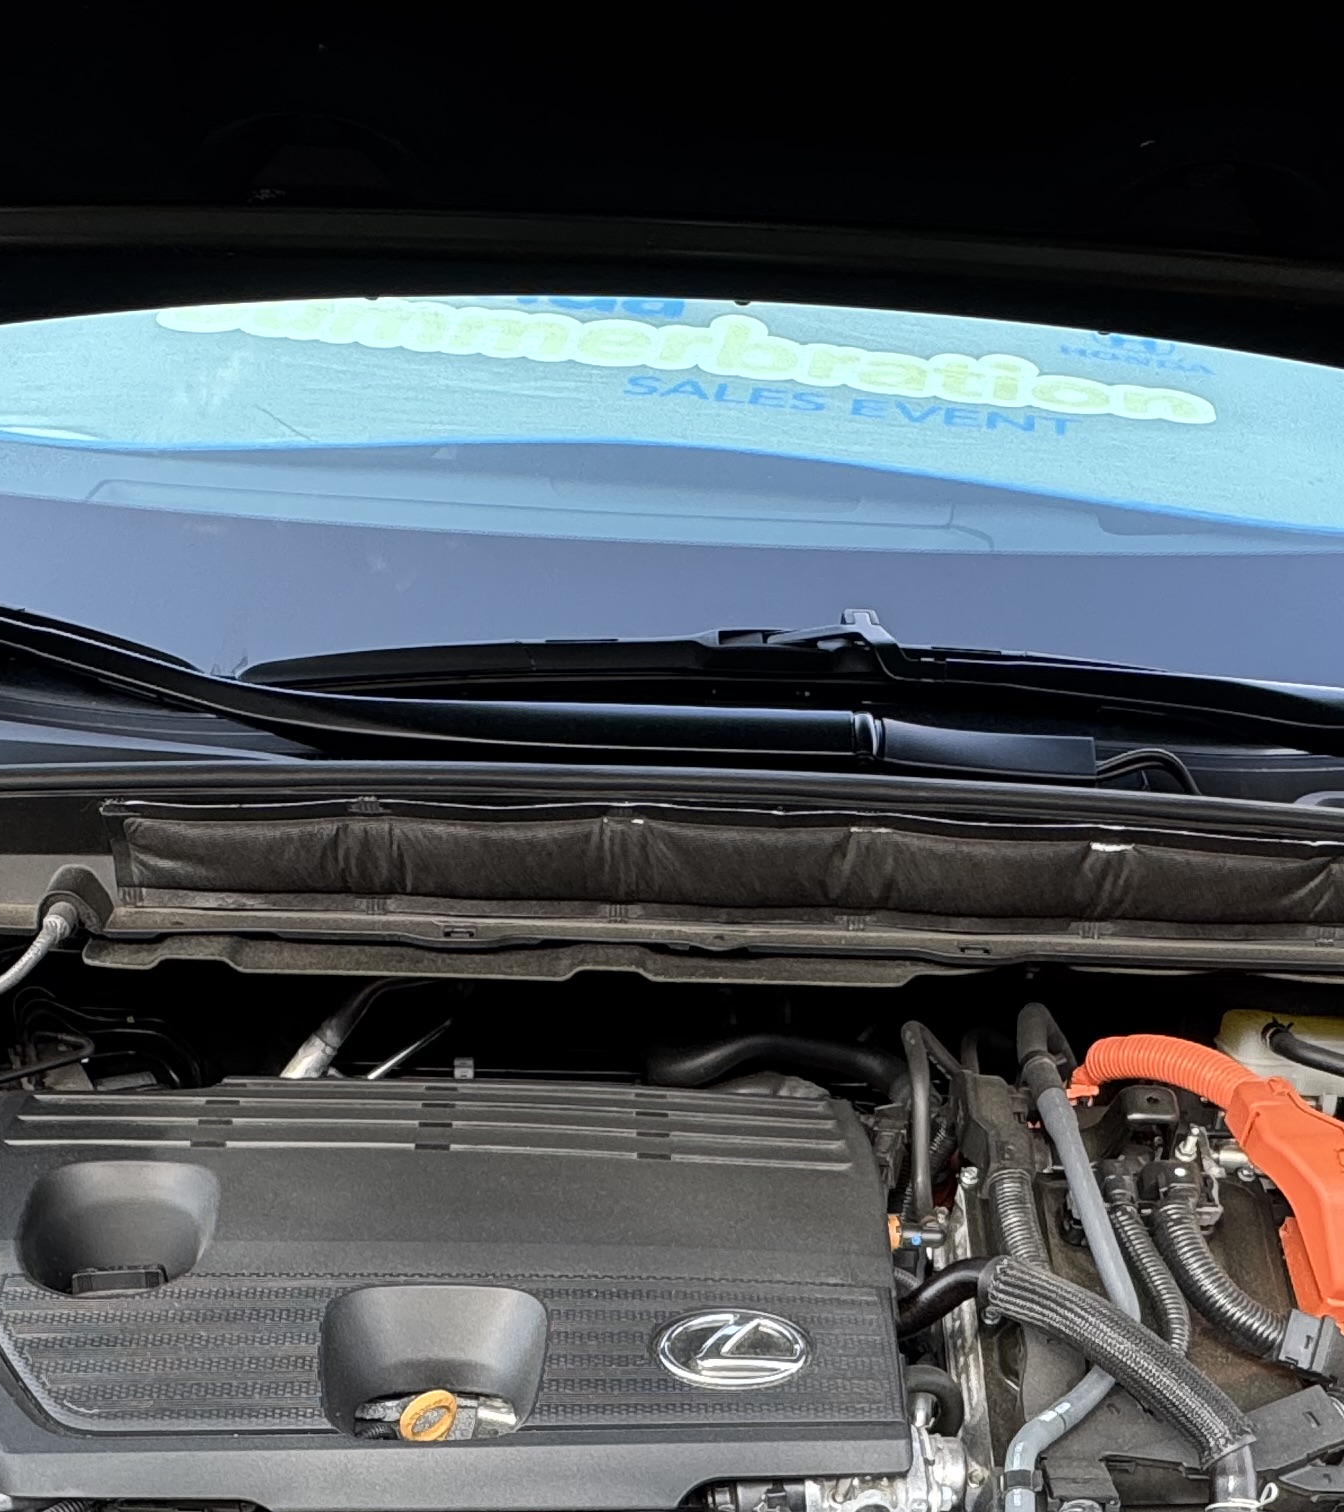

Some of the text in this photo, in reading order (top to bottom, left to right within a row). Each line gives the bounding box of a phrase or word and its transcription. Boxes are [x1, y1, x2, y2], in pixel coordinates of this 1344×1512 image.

[162, 297, 1212, 422] ummerbration
[1059, 342, 1216, 375] HONDA
[622, 374, 1084, 436] SALES EVENT
